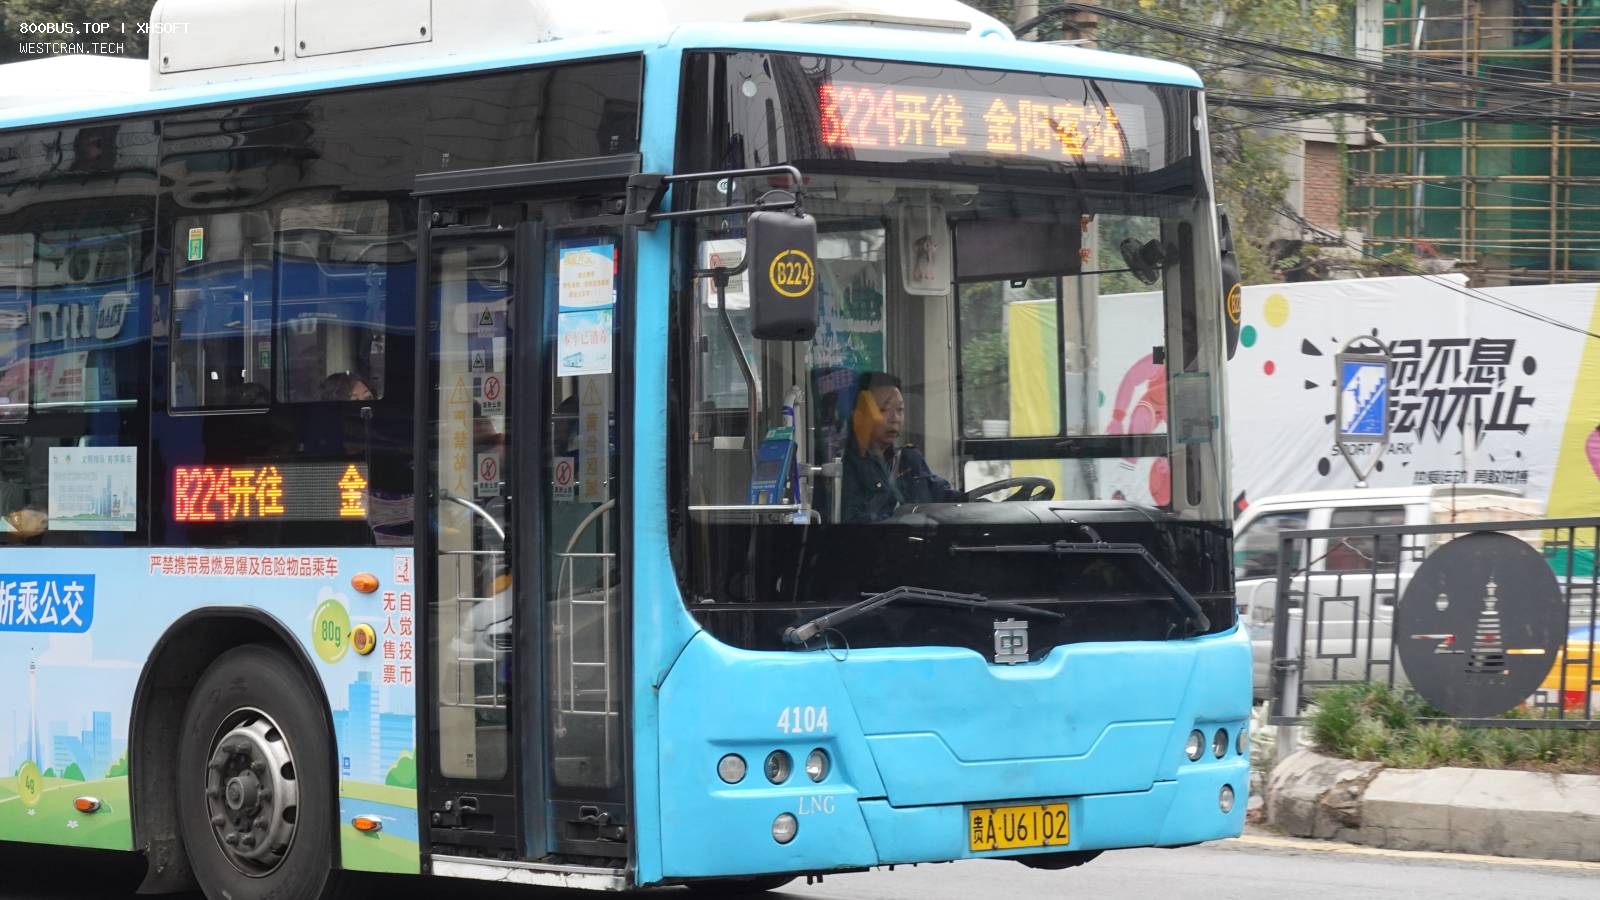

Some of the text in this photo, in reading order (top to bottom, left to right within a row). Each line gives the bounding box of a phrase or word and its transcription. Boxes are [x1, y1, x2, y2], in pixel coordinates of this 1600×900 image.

[983, 97, 1121, 158] 金阳客站
[777, 261, 810, 286] B224
[1345, 338, 1517, 390] 命不息
[1387, 442, 1413, 455] ARK
[175, 464, 368, 521] B224开往 金
[150, 555, 338, 577] 严禁携带易燃易爆及危险物品乘车
[322, 620, 341, 648] 80g
[383, 592, 396, 684] 无人售票
[399, 591, 413, 685] 自觉投币
[776, 704, 829, 734] 4104
[798, 795, 836, 816] LNG
